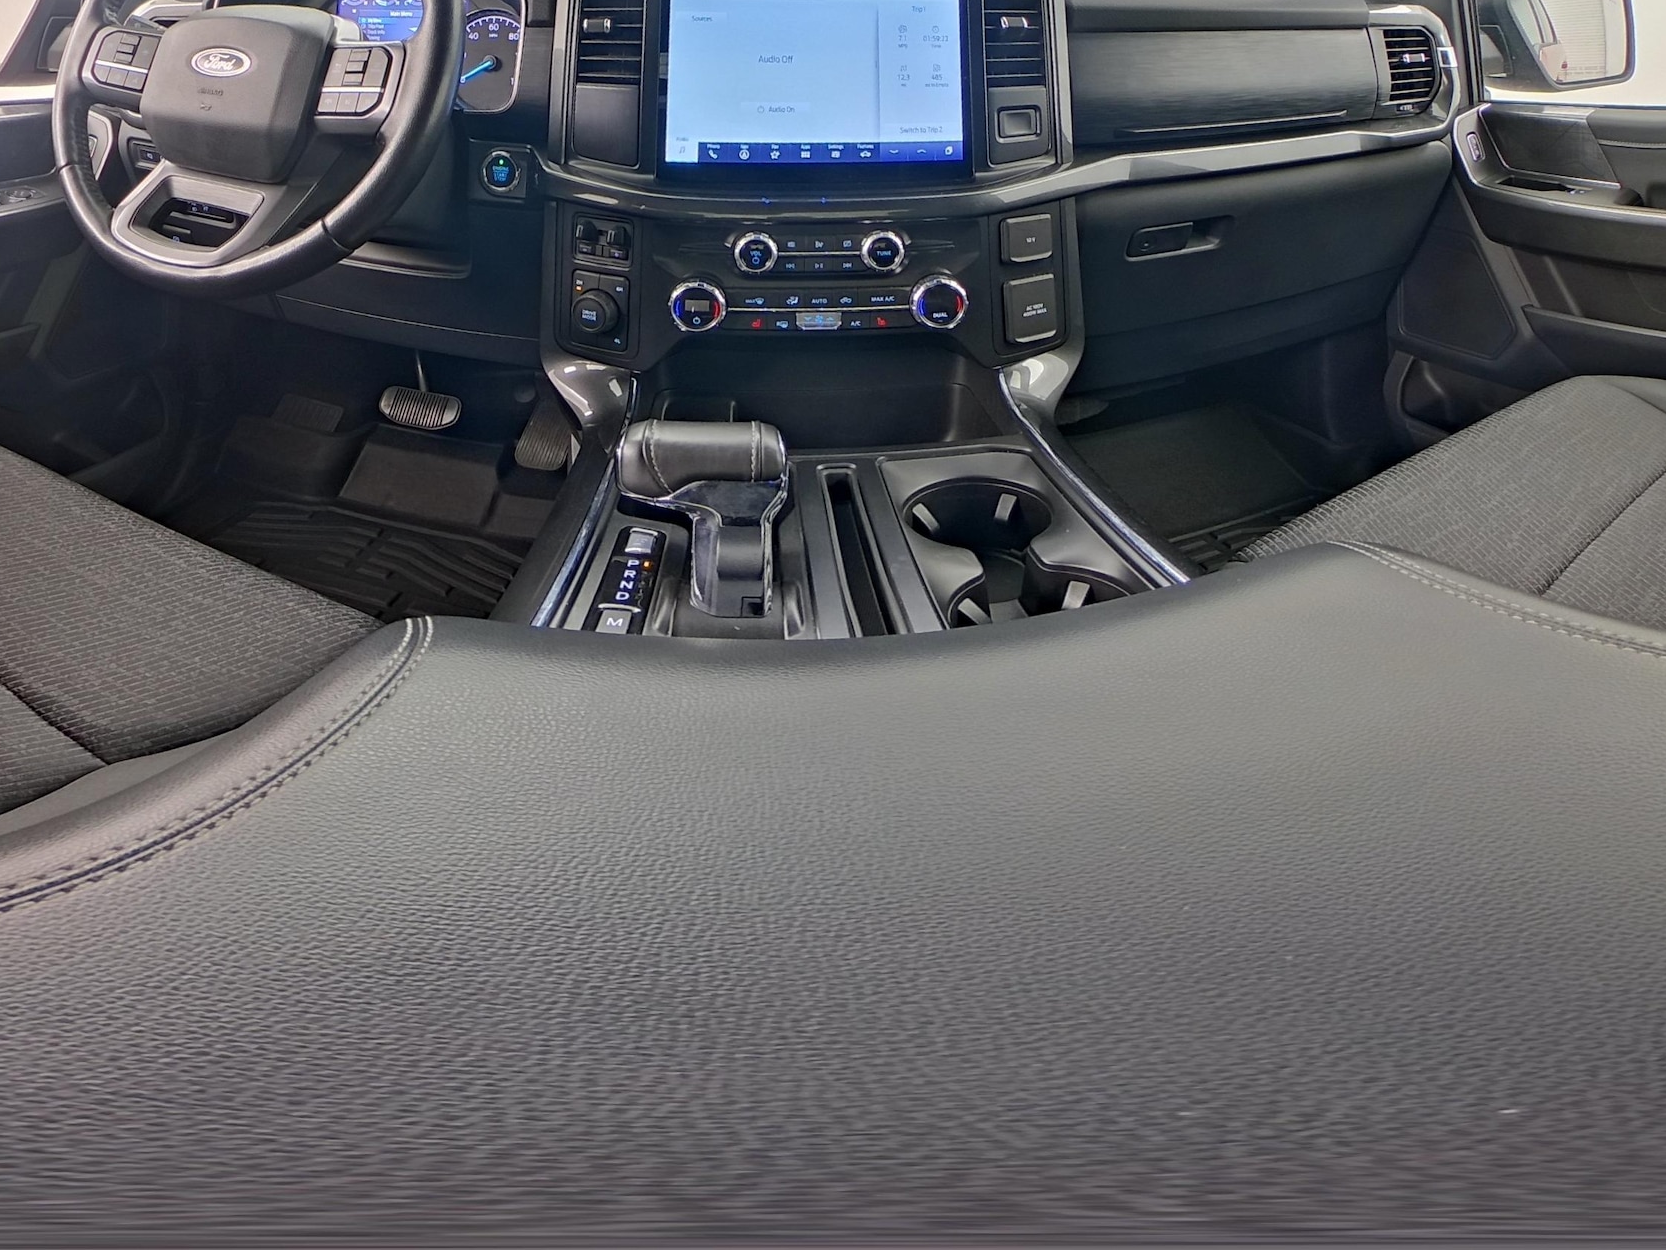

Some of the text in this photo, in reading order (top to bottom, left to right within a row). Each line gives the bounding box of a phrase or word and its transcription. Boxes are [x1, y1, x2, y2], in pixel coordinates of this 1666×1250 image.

[488, 23, 500, 31] 60
[468, 32, 479, 40] 40
[508, 33, 520, 41] 80
[203, 53, 237, 70] Ford
[758, 55, 794, 64] Audio Off
[927, 126, 939, 134] Trip
[627, 559, 640, 567] P
[623, 569, 637, 578] R
[619, 581, 634, 589] N
[615, 591, 630, 600] D
[606, 617, 624, 627] M
